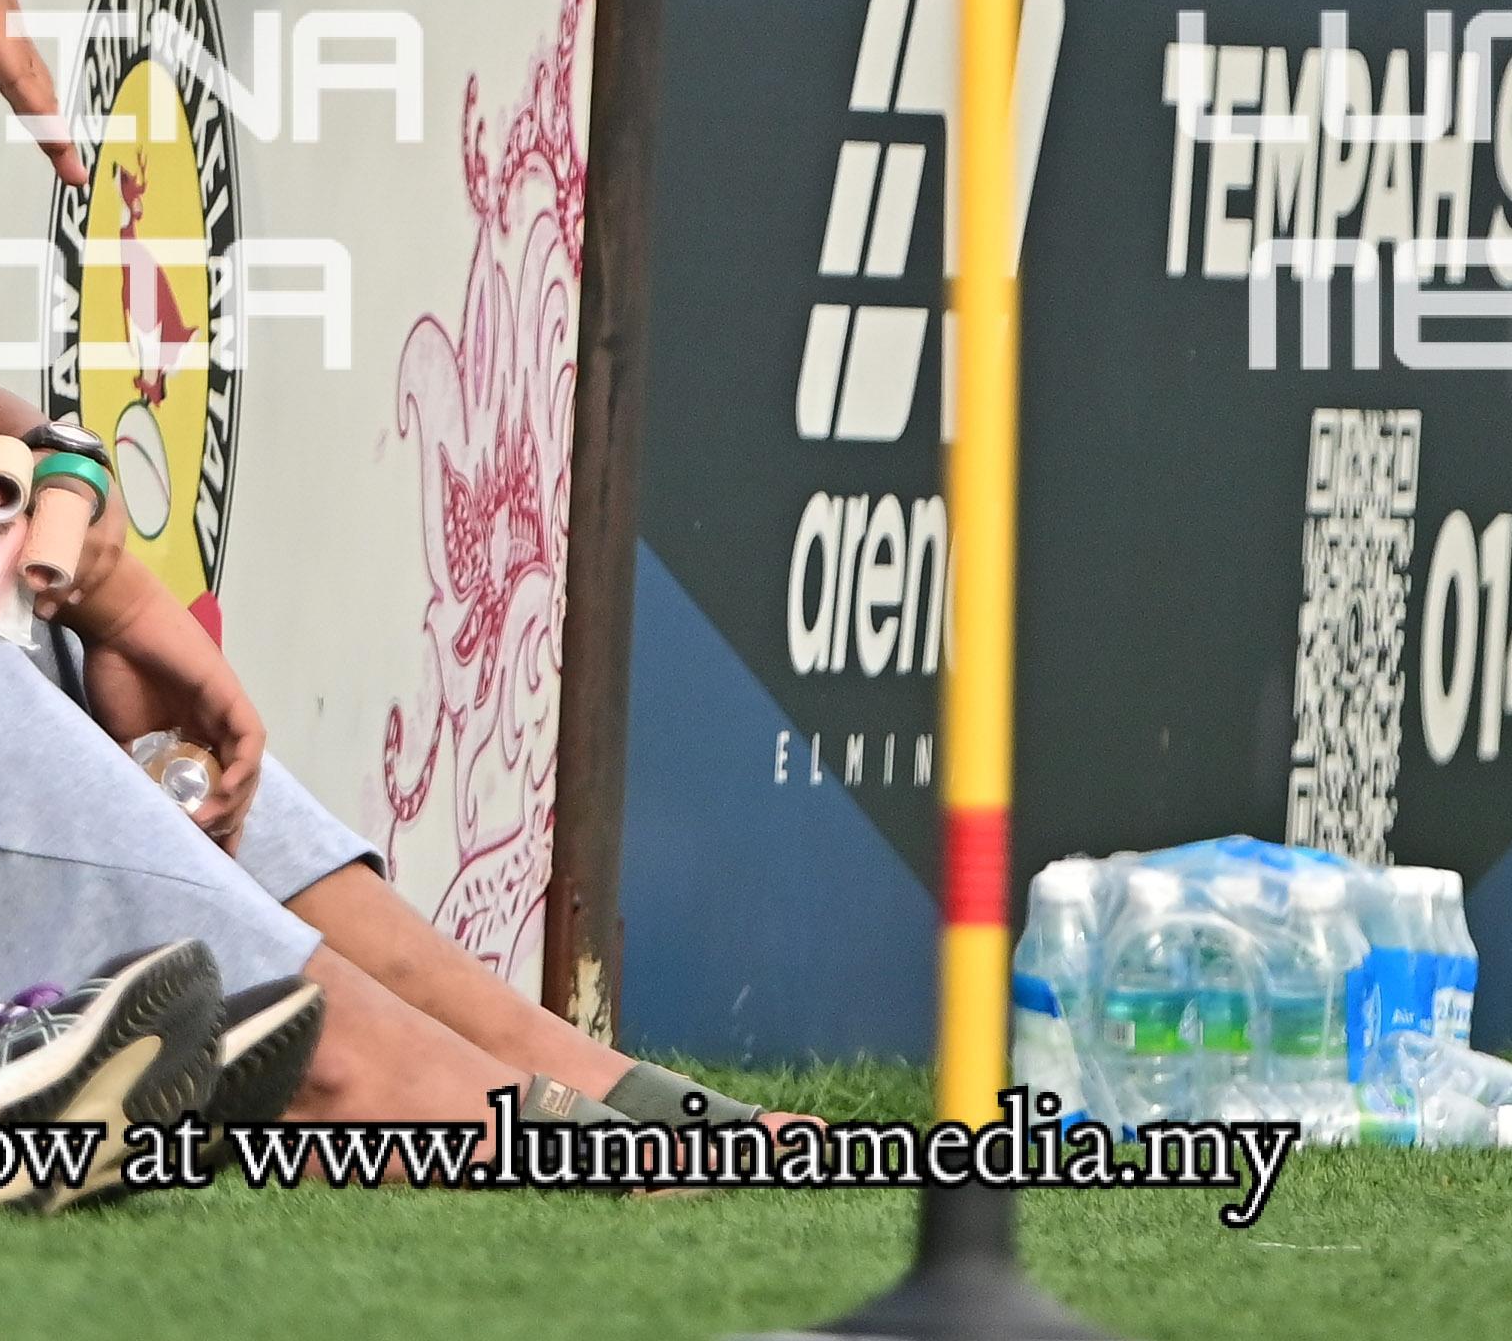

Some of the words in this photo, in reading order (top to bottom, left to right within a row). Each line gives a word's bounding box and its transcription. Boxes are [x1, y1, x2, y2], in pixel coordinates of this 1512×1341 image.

[1161, 41, 1482, 285] TEMPAH
[786, 489, 961, 678] aren
[772, 728, 944, 787] ELMIN
